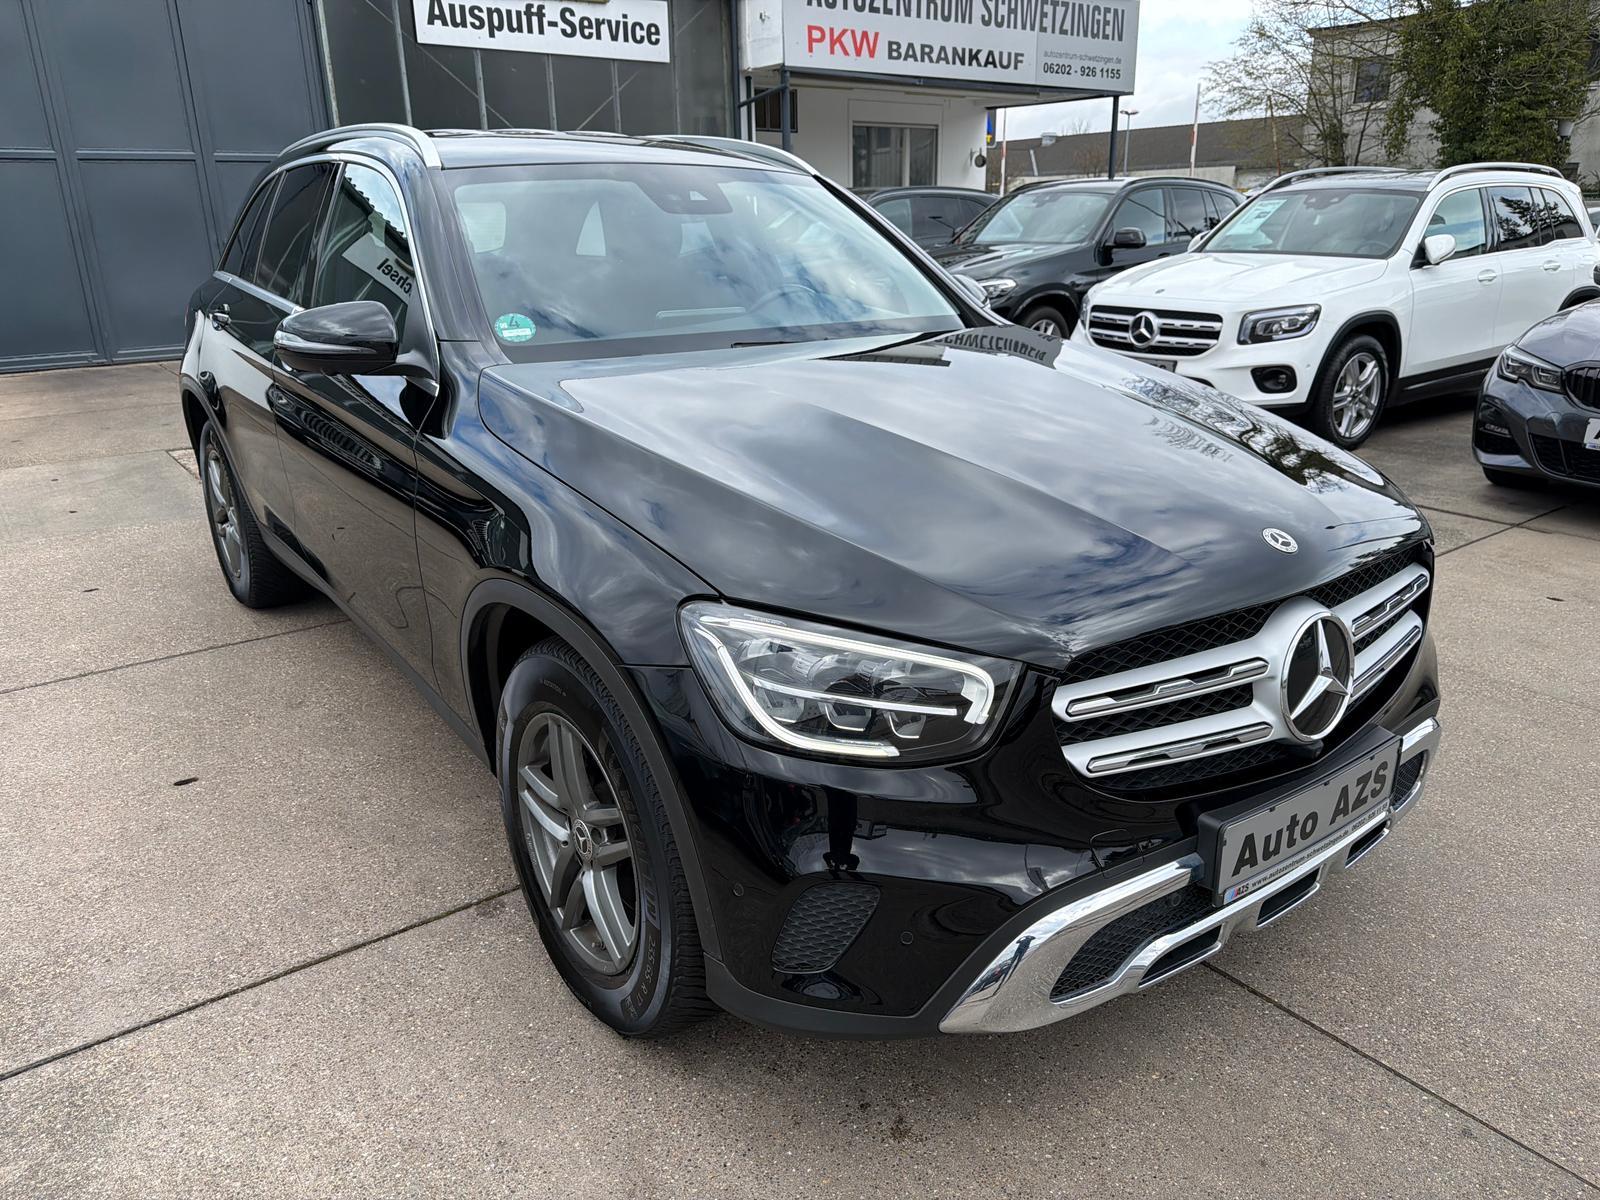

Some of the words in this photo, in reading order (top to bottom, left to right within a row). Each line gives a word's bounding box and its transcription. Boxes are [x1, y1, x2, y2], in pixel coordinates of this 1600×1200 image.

[427, 0, 660, 46] Auspuff-Service
[981, 0, 1125, 42] SCHWETZINGEN
[806, 25, 880, 59] PKW
[887, 40, 1025, 70] BARANKAUF
[1043, 62, 1072, 75] 06202
[1080, 66, 1097, 77] 926
[1100, 67, 1121, 80] 1155
[1231, 811, 1319, 877] Auto
[1329, 761, 1389, 826] AZS
